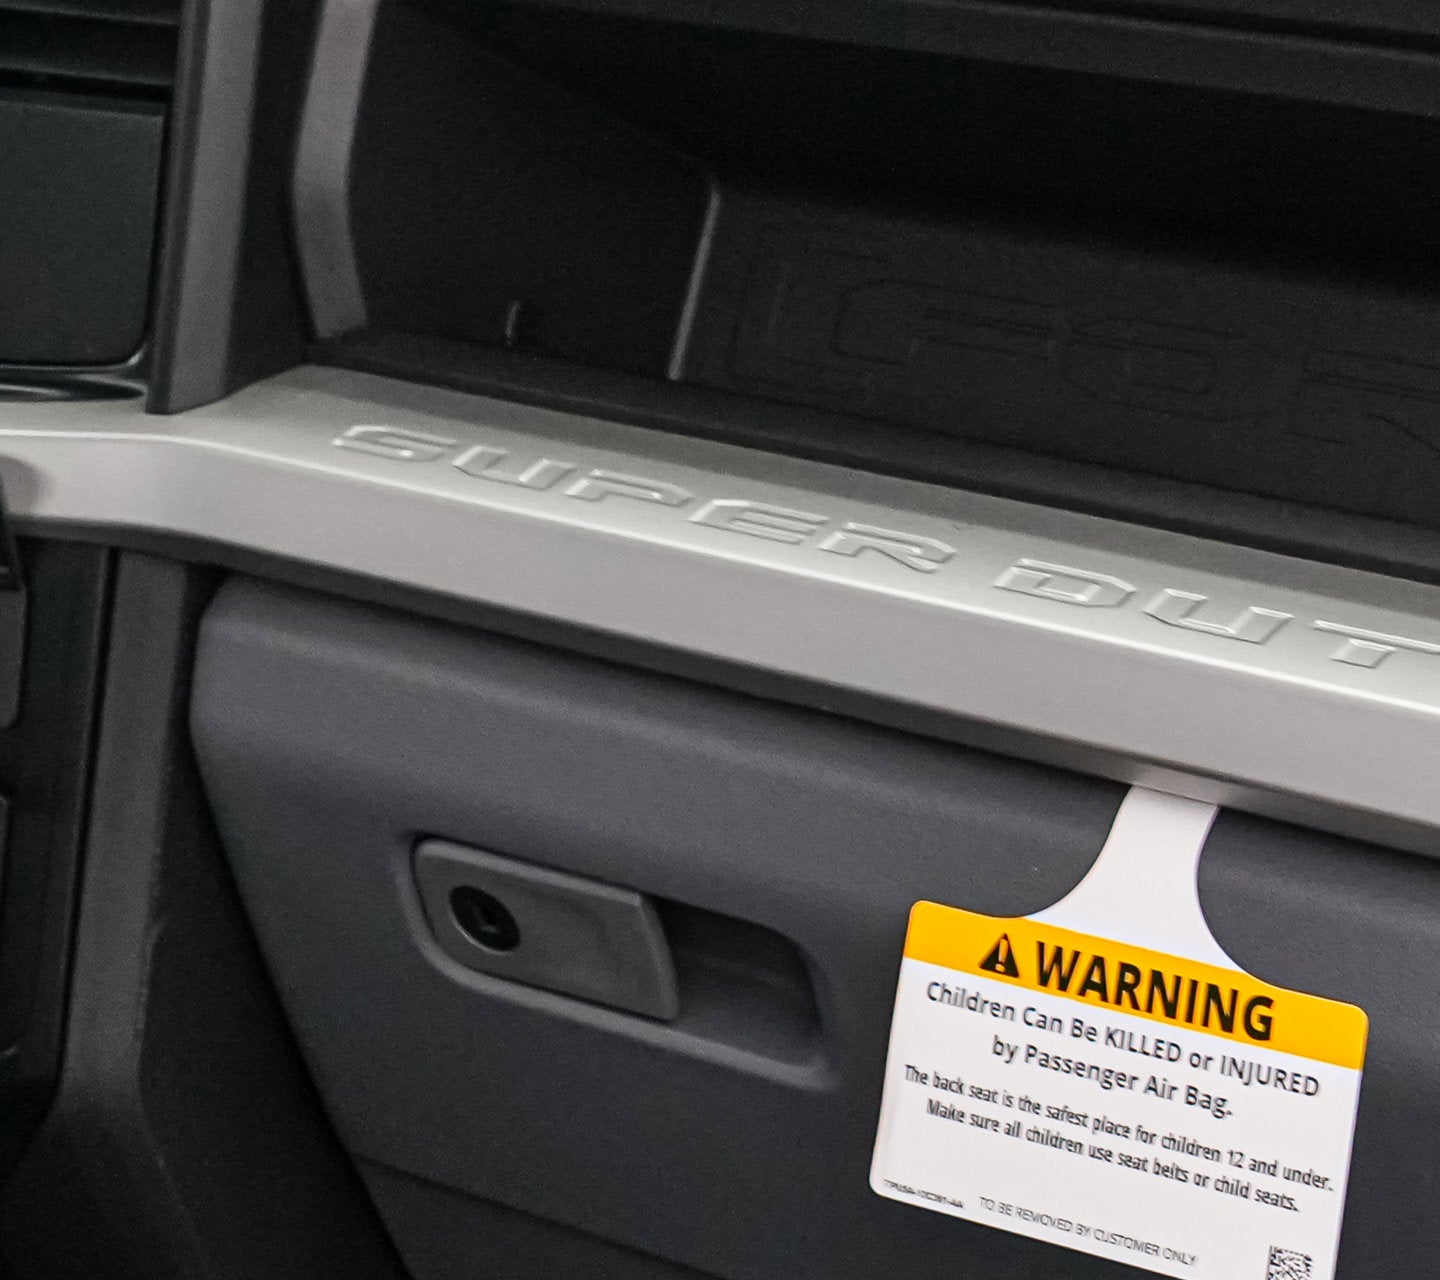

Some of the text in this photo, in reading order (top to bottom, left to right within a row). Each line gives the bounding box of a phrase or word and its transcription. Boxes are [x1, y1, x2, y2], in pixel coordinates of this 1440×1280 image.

[332, 424, 958, 573] SUPER
[926, 981, 1320, 1097] Children Can Be KILLED or INJURED
[1036, 940, 1275, 1042] WARNING
[904, 1064, 1335, 1192] The back seat is the safest place for children 12 and under.
[992, 1034, 1234, 1119] by Passenger Air Bag.
[925, 1097, 1302, 1213] Make sure all children use seat belts or child seats.
[978, 1195, 1199, 1267] TO BE REMOVED BY CUSTOMER ONLY
